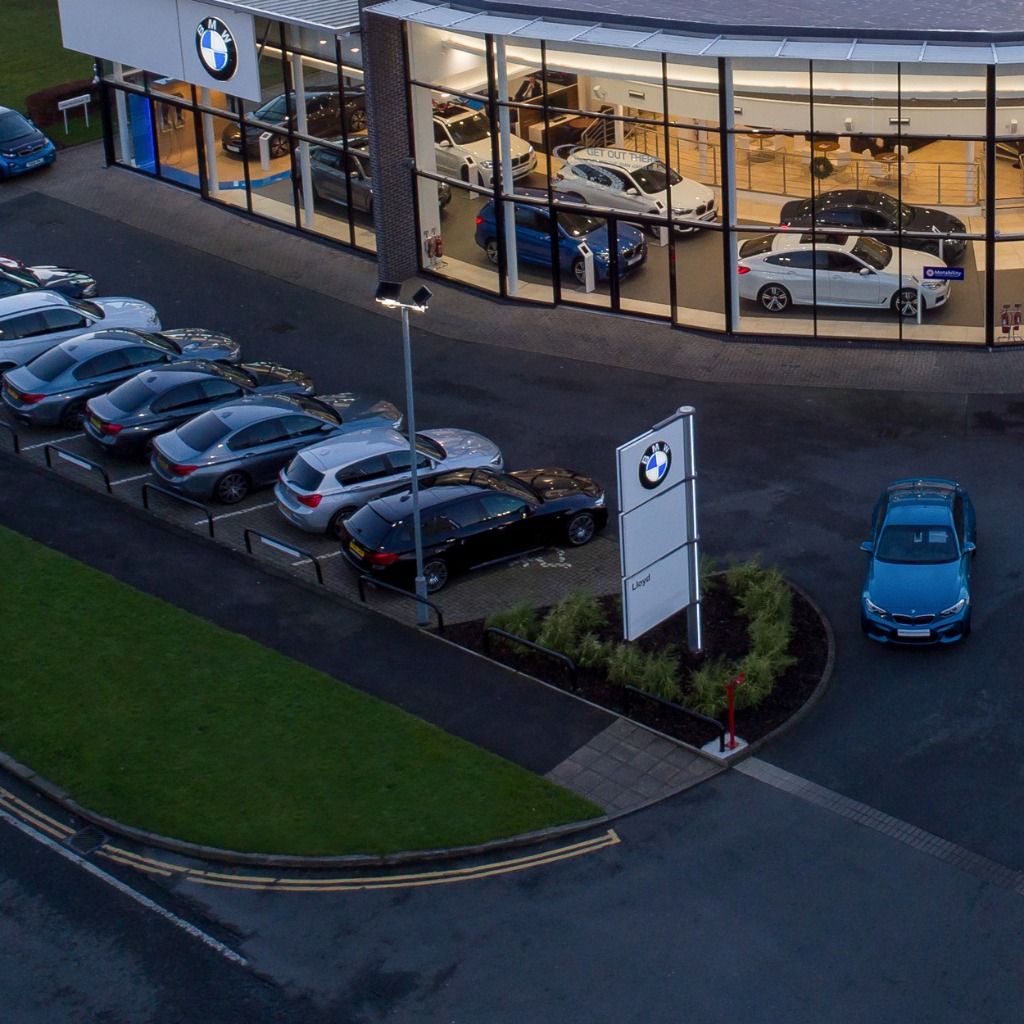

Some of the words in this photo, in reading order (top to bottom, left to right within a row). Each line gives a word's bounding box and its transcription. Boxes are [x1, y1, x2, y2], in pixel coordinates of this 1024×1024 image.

[197, 19, 232, 44] BMW
[587, 147, 605, 158] GET
[607, 149, 627, 160] OUT
[641, 442, 670, 465] BMW
[631, 574, 651, 591] Lloyd
